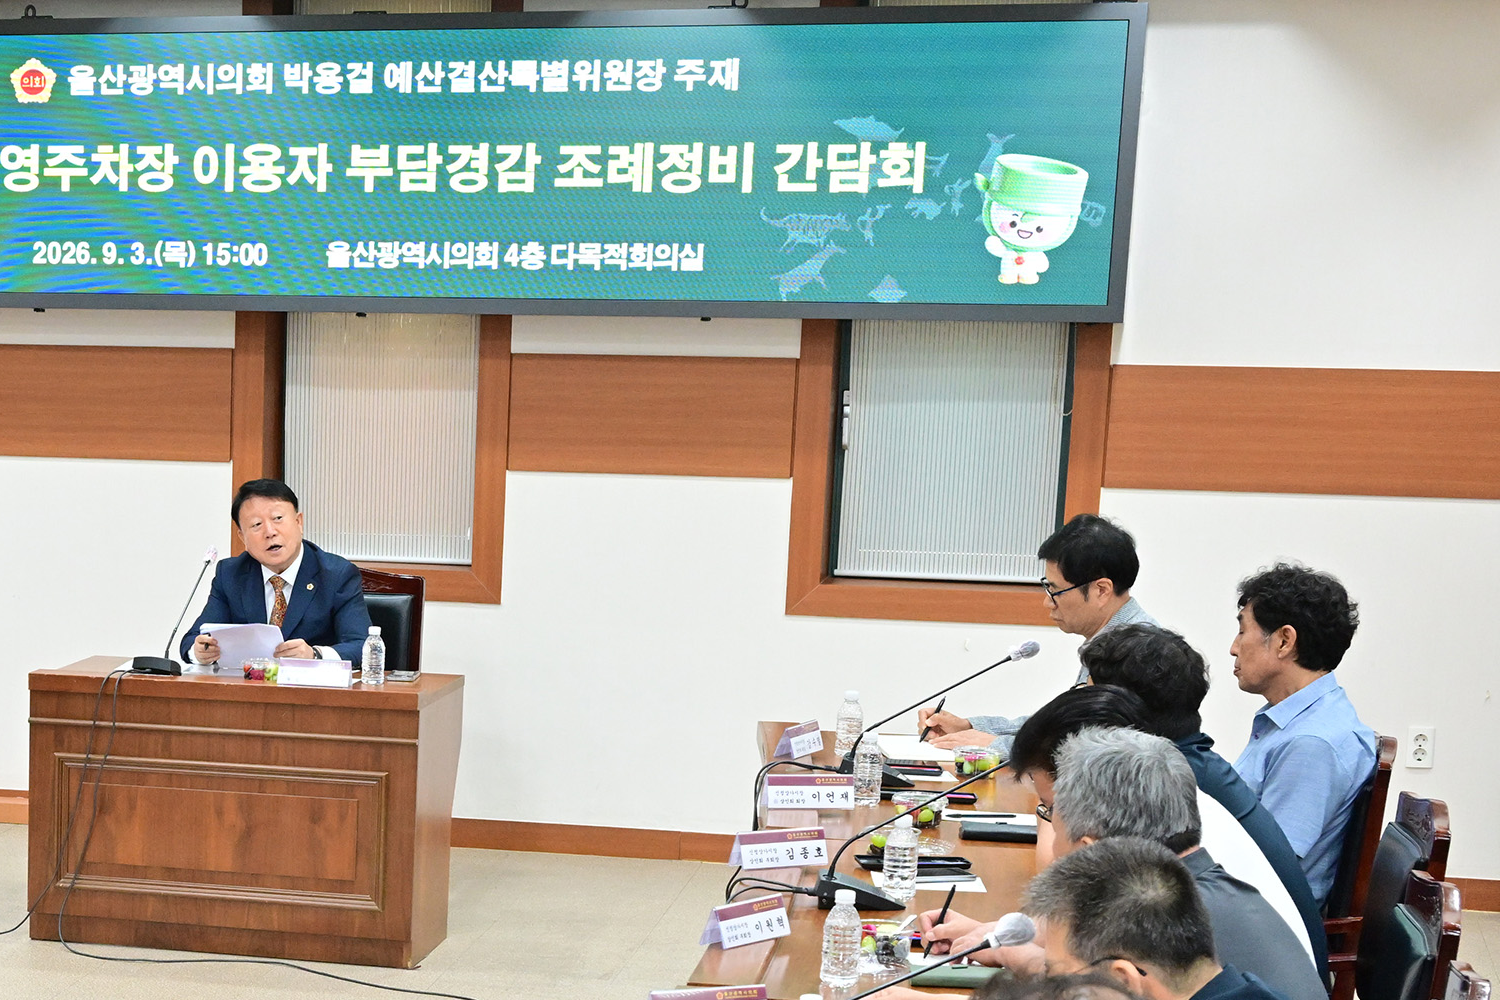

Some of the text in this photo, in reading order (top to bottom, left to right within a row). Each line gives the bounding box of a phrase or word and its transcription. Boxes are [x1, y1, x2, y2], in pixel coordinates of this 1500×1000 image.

[22, 75, 45, 88] 의회
[67, 57, 741, 96] 울산광역시의회 박용걸 예산결산특별위원장 주재
[193, 142, 333, 193] 이용자
[345, 142, 542, 193] 부담경감
[554, 142, 755, 194] 조례정비
[773, 141, 927, 194] 간담회
[202, 242, 268, 267] 15:00
[326, 240, 705, 272] 울산광역시의회 4층 다목적회의실
